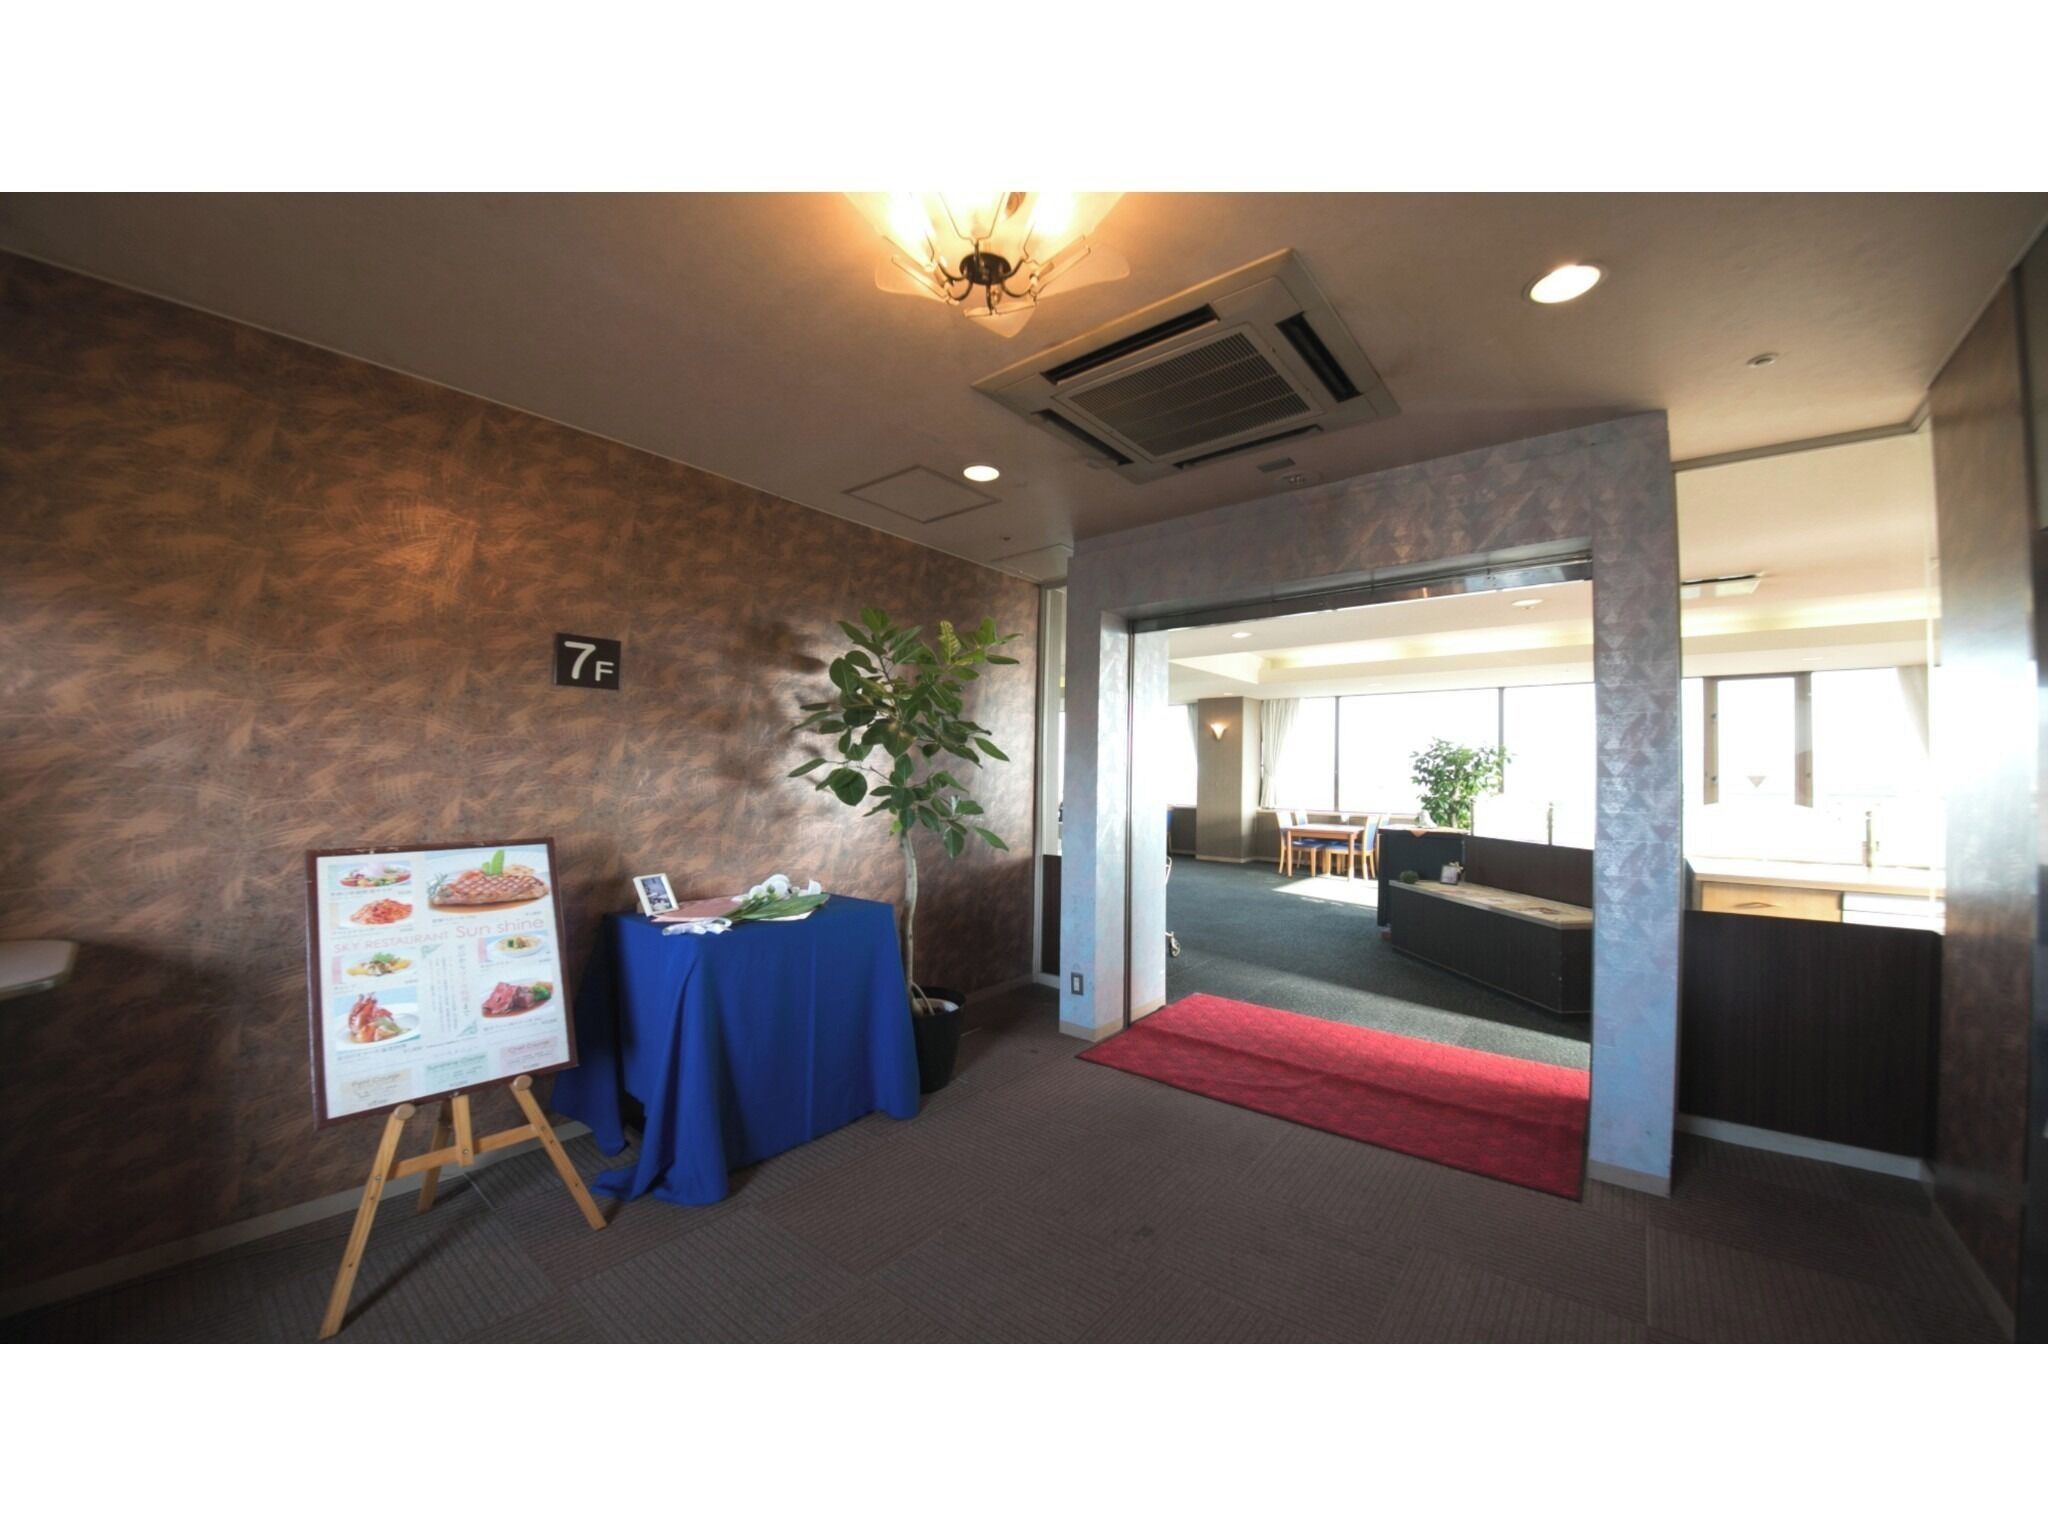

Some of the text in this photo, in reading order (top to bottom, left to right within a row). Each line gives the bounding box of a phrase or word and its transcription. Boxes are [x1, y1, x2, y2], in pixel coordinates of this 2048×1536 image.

[563, 640, 615, 682] 7F
[333, 940, 361, 954] SKY
[365, 930, 449, 950] RESTAURANT
[455, 922, 491, 938] Sun
[496, 915, 545, 934] shine
